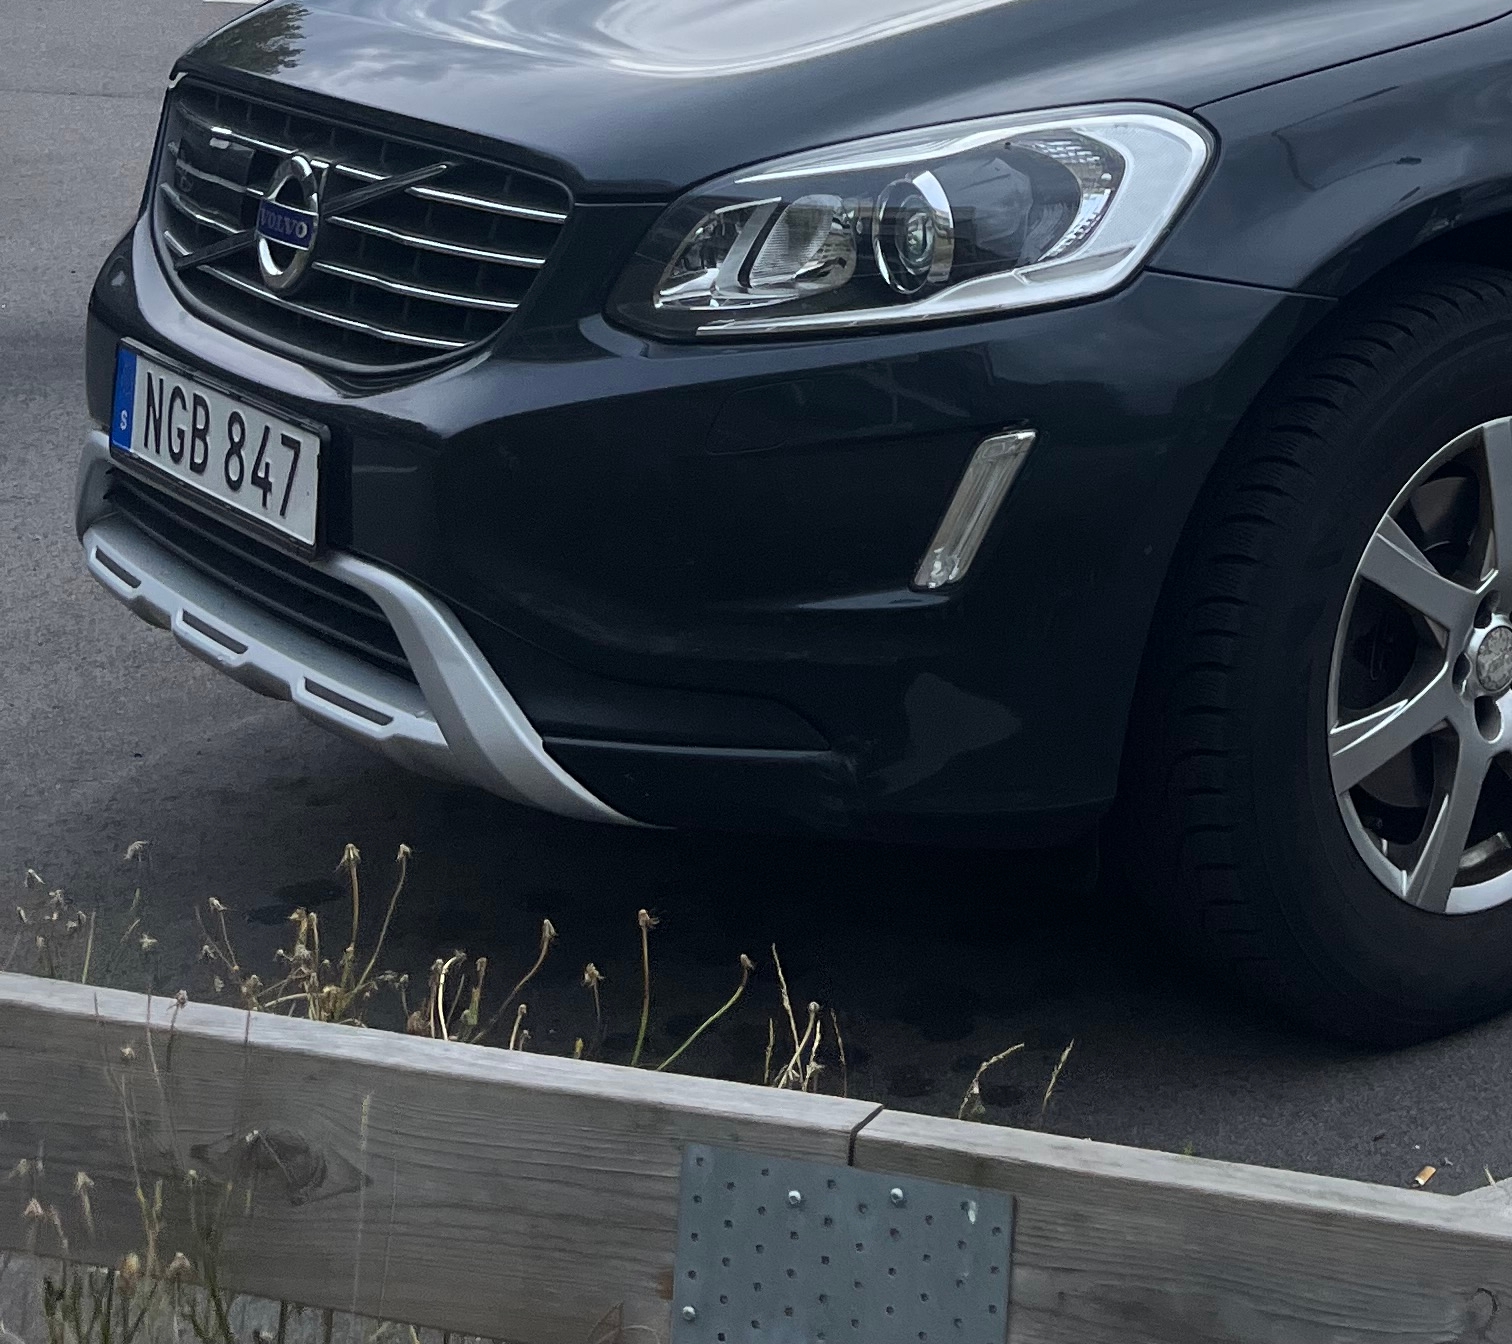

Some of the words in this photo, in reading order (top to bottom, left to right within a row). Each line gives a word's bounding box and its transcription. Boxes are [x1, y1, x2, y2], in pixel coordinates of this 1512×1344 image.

[260, 208, 308, 239] VOLVO
[119, 409, 129, 432] S
[143, 371, 212, 475] NGB
[223, 410, 302, 518] 847
